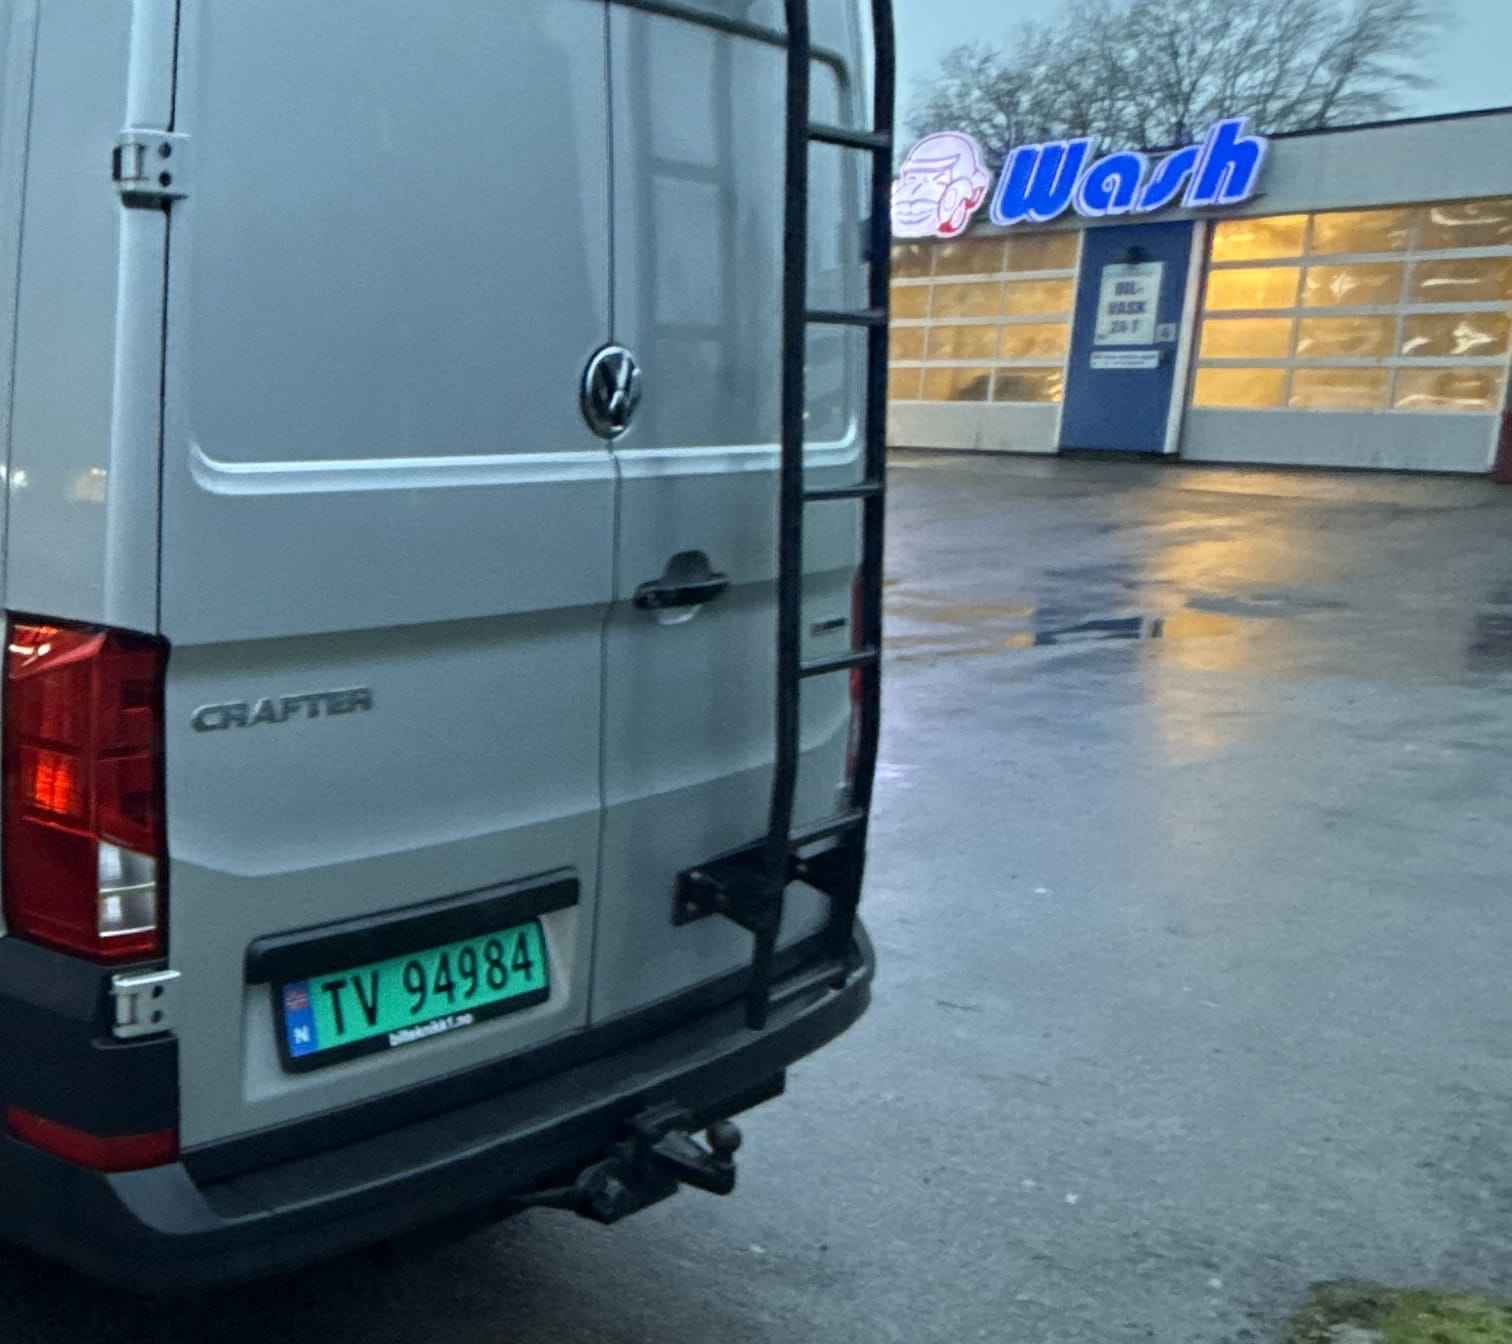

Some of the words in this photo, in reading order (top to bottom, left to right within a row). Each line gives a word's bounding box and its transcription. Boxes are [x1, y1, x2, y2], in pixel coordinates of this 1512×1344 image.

[991, 117, 1267, 225] Wash
[191, 687, 372, 732] CRAFTER
[322, 971, 379, 1035] TV
[403, 931, 533, 1014] 94984
[293, 1025, 310, 1044] N
